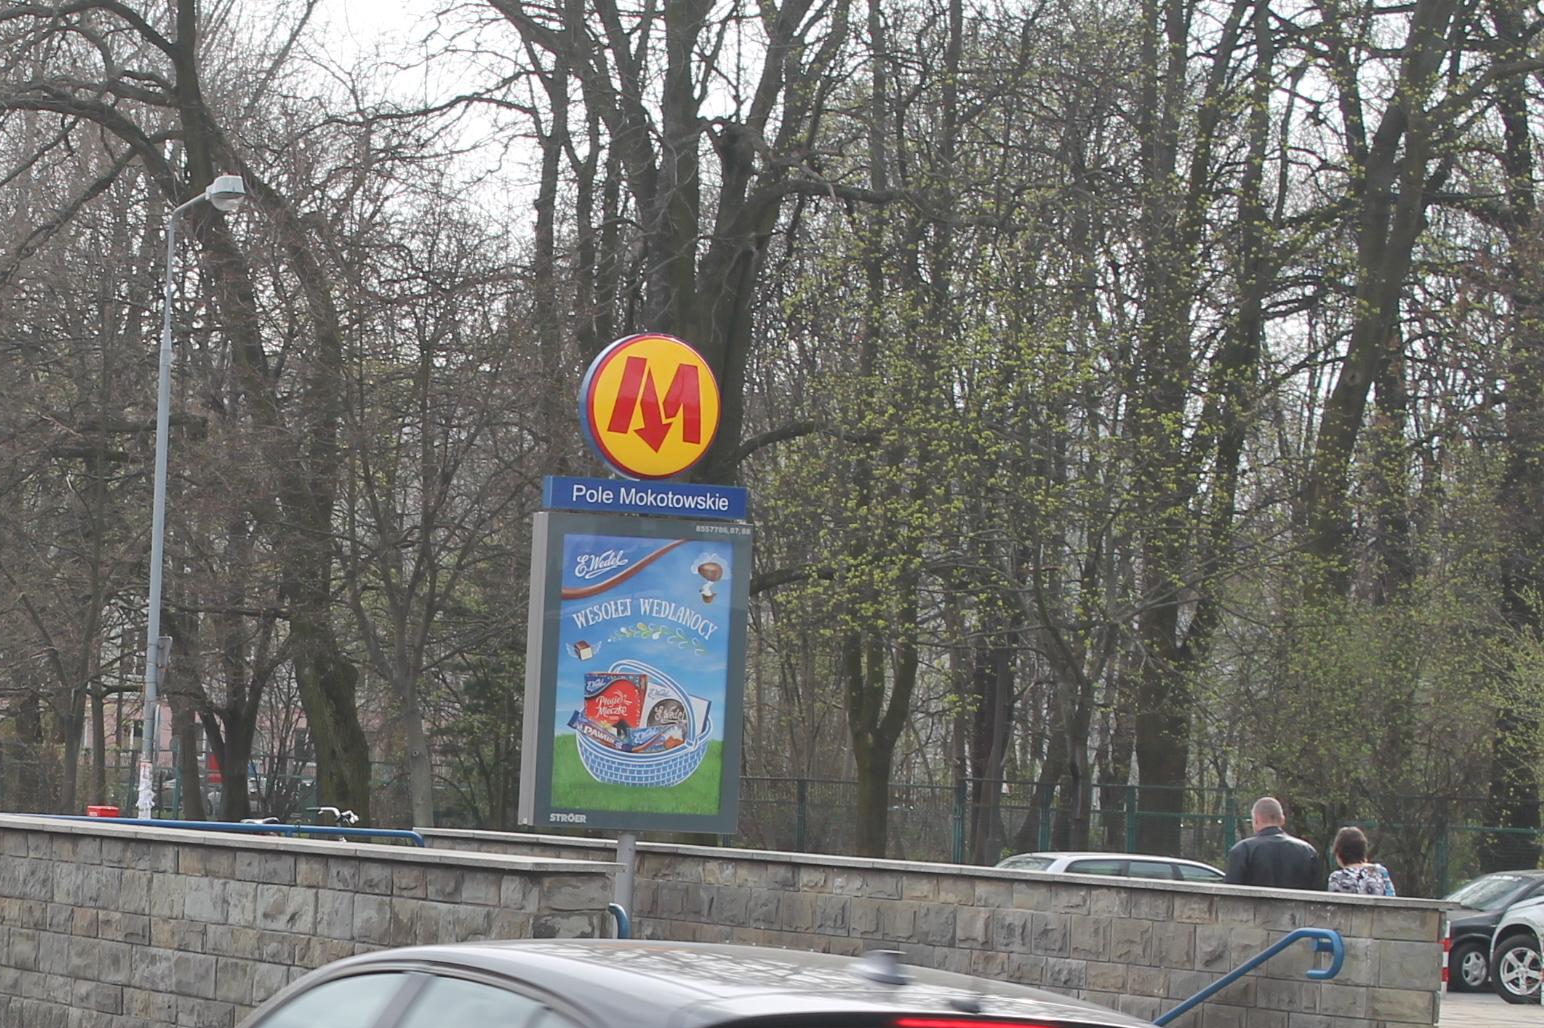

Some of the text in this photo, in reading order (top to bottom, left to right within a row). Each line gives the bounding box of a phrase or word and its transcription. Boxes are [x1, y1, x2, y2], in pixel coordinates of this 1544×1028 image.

[572, 484, 729, 511] Pole Mokotowskie
[639, 598, 719, 641] WEDLANOCY
[549, 813, 587, 823] STRÖER
